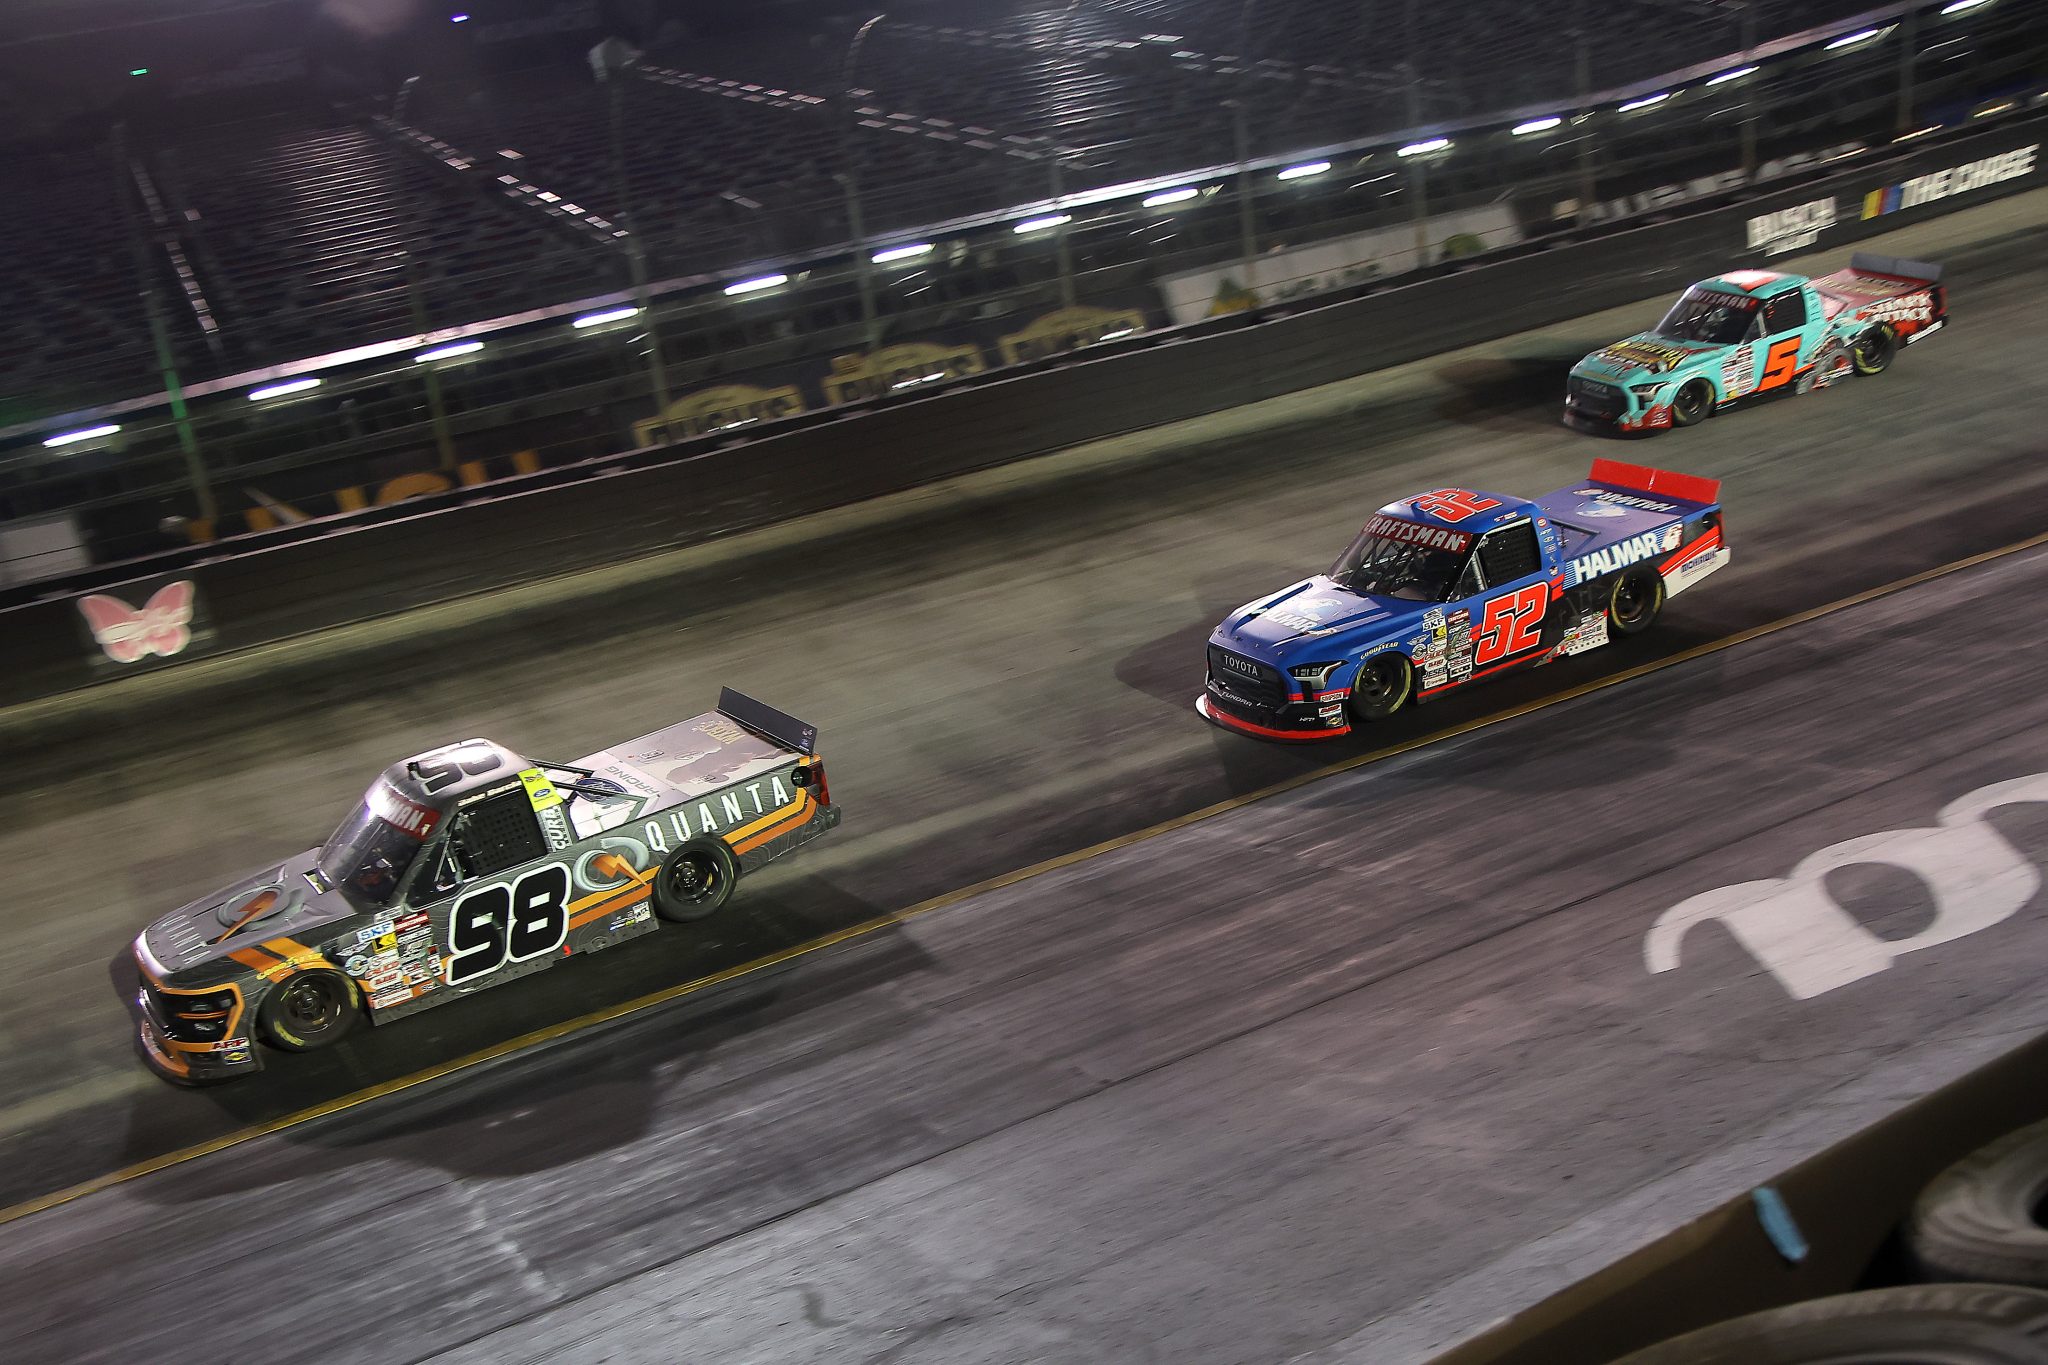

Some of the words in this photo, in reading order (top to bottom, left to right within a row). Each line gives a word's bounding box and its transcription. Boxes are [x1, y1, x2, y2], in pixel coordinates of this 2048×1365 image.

[1757, 334, 1803, 392] 5
[1401, 488, 1503, 523] 52
[1364, 516, 1465, 551] CRAFTSMAN
[1573, 532, 1661, 584] HALMAR
[1423, 618, 1444, 631] SKF
[1475, 582, 1549, 665] 52
[1224, 654, 1258, 676] TOYOTA
[1360, 641, 1399, 660] GOODYEAR
[1221, 691, 1253, 707] TUNDRA
[605, 765, 660, 795] RACING
[645, 776, 790, 853] QUANTA
[360, 923, 391, 940] SKF
[447, 862, 573, 986] 98
[213, 1038, 246, 1050] ARP
